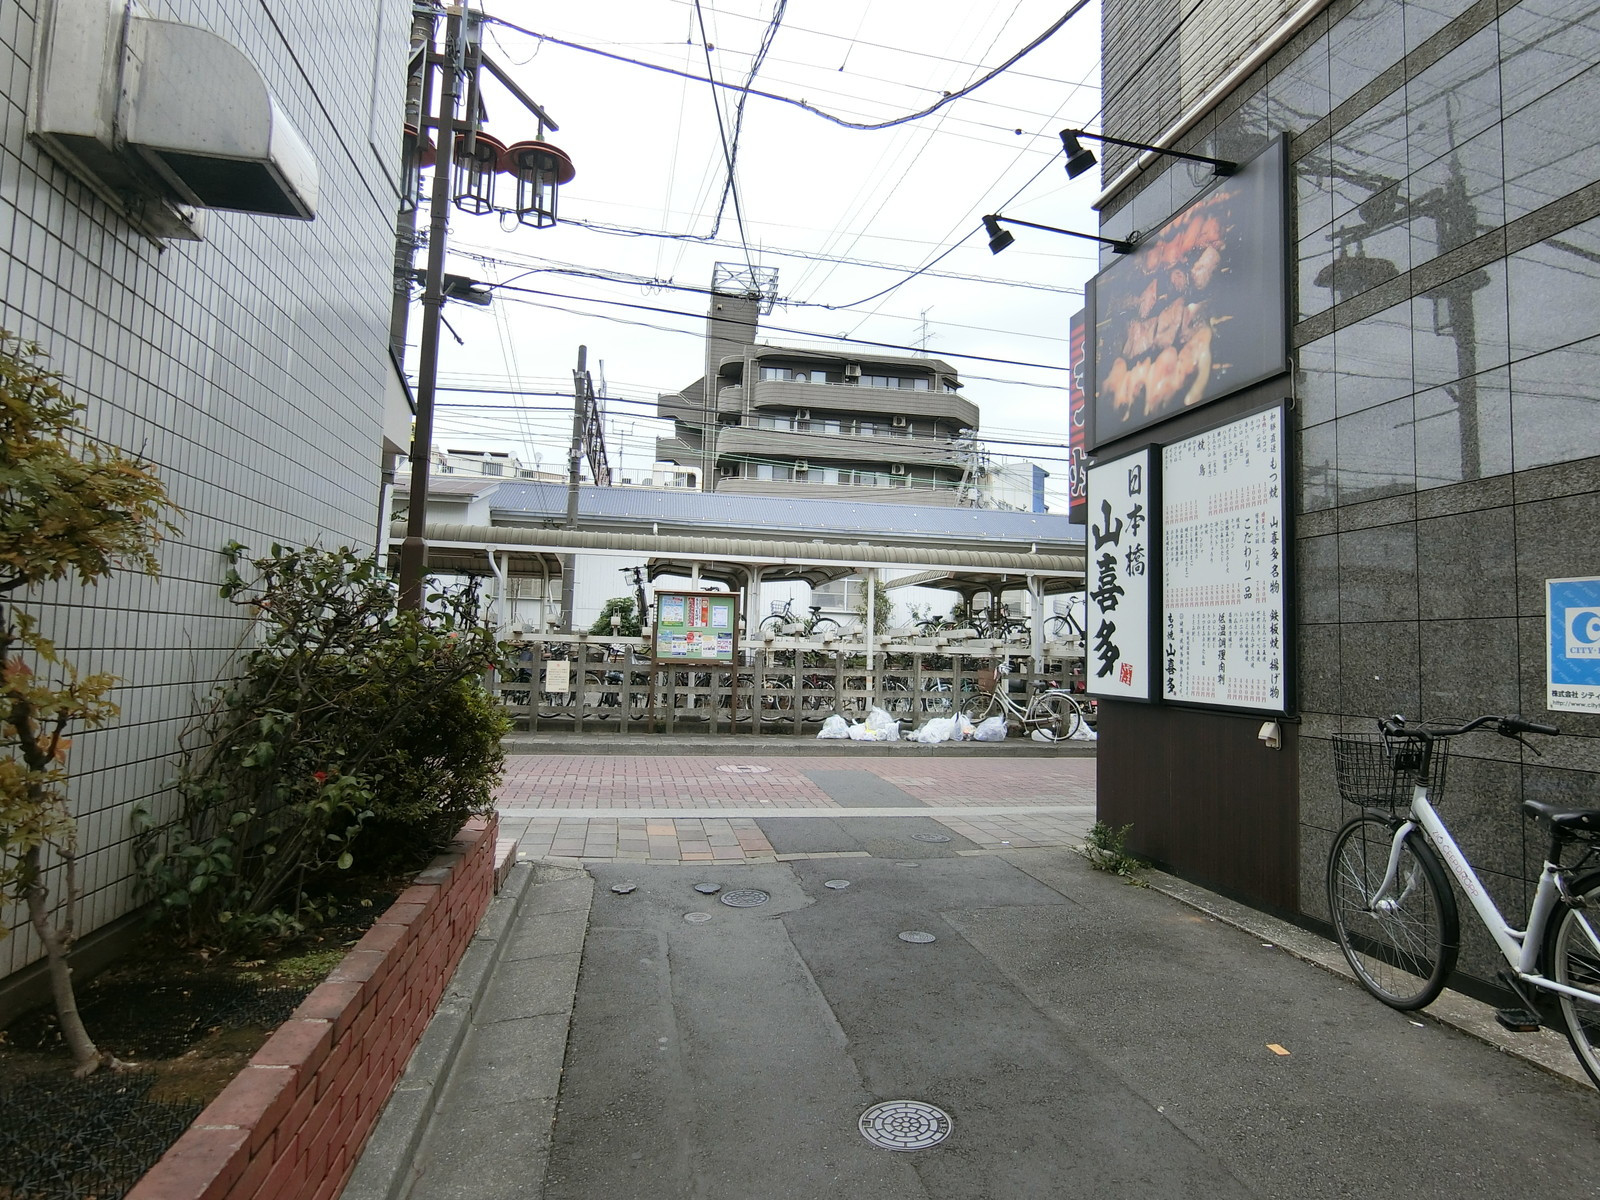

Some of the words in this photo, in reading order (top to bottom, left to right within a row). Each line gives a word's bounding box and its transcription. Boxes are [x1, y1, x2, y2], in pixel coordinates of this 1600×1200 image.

[1125, 464, 1146, 577] 日本橋
[1244, 517, 1253, 599] こだわり一品
[1270, 515, 1279, 594] 山喜多名物
[1090, 499, 1125, 678] 山喜多
[1552, 690, 1579, 699] 株式会社
